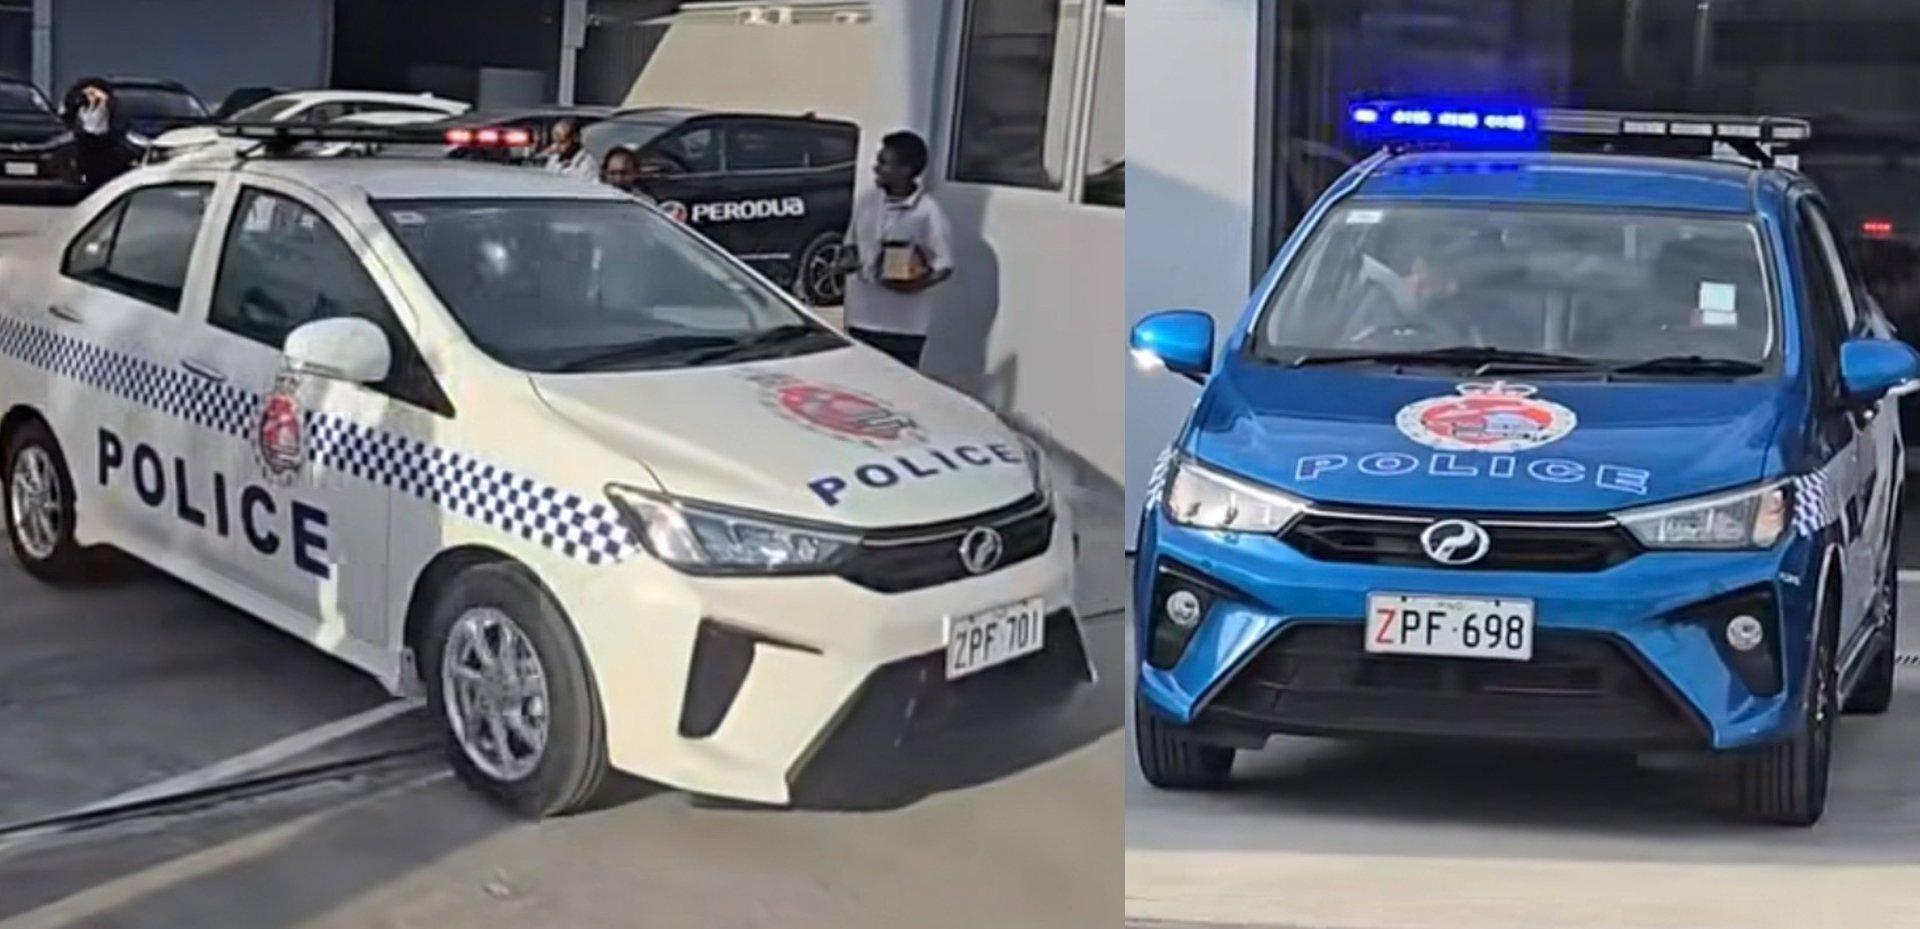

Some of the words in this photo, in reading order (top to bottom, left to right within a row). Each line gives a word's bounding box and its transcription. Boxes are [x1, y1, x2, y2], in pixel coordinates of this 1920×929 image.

[98, 426, 331, 579] POLICE
[807, 443, 1022, 507] POLICE
[1295, 453, 1650, 495] POLICE
[954, 622, 998, 670] ZPF
[1006, 609, 1038, 651] 701
